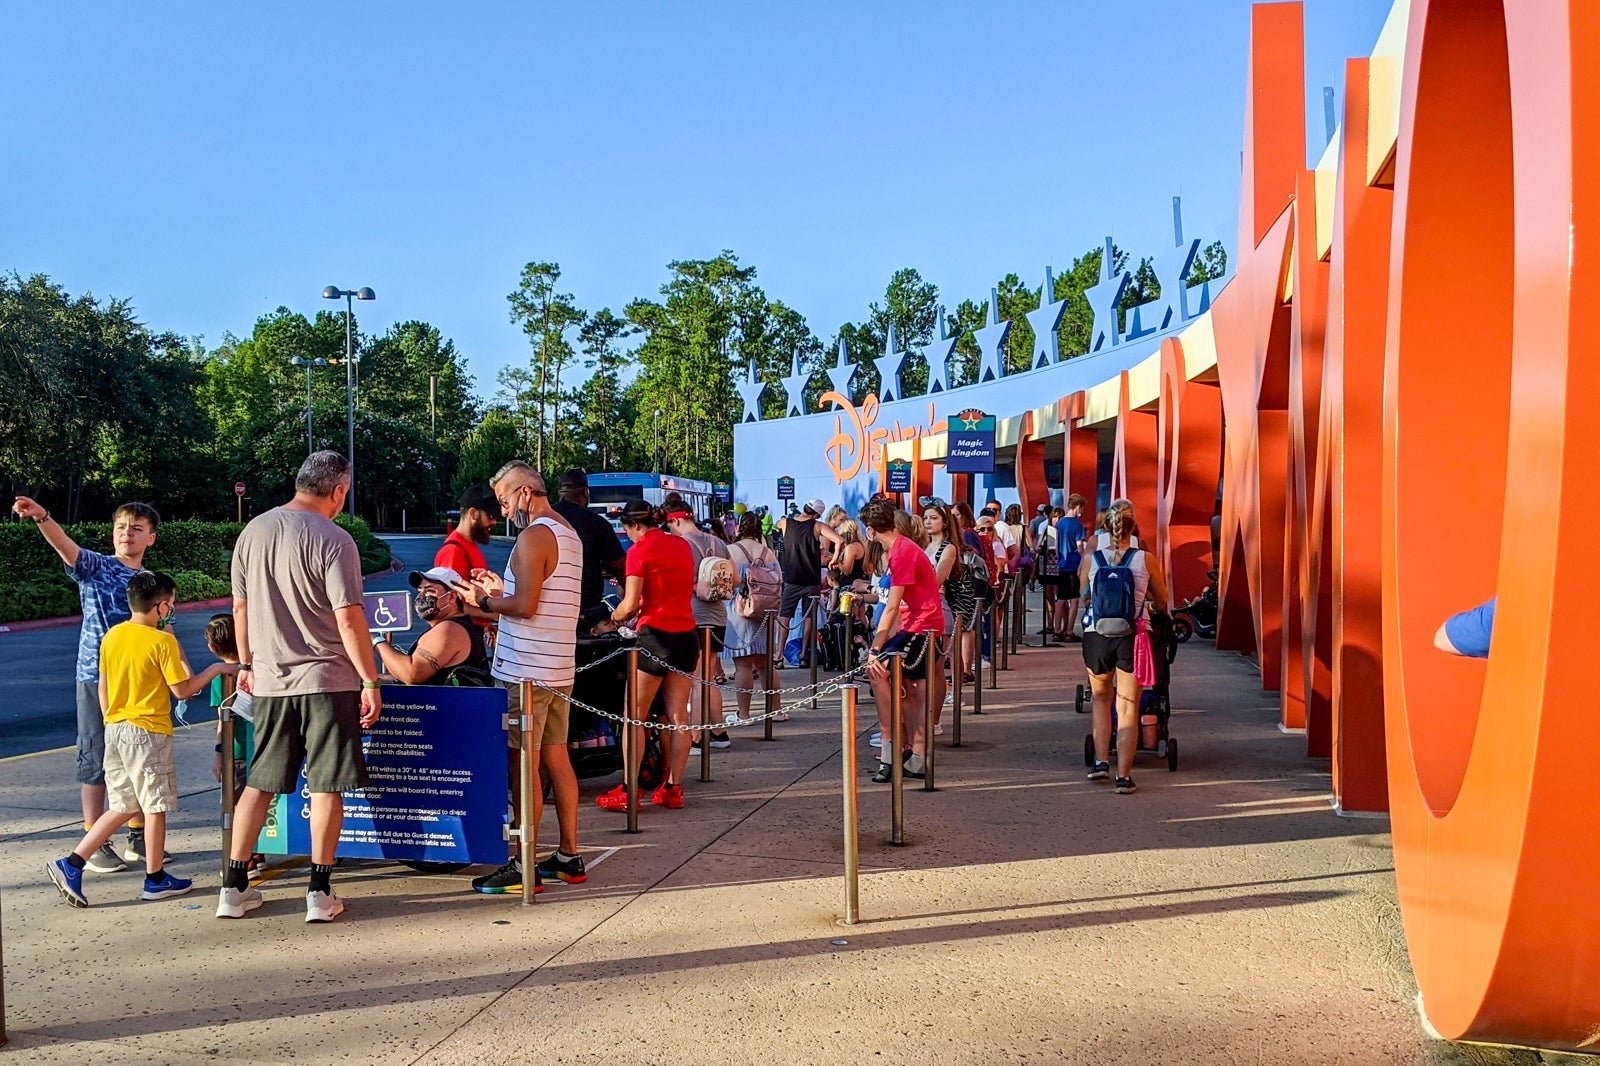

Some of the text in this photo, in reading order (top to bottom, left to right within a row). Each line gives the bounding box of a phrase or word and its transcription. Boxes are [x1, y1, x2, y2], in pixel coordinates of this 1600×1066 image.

[818, 391, 948, 485] Dis'
[957, 439, 984, 447] Magic
[951, 449, 990, 458] Kingdom
[406, 703, 424, 711] yellow
[266, 793, 278, 838] BOAR
[408, 808, 440, 816] encouraged
